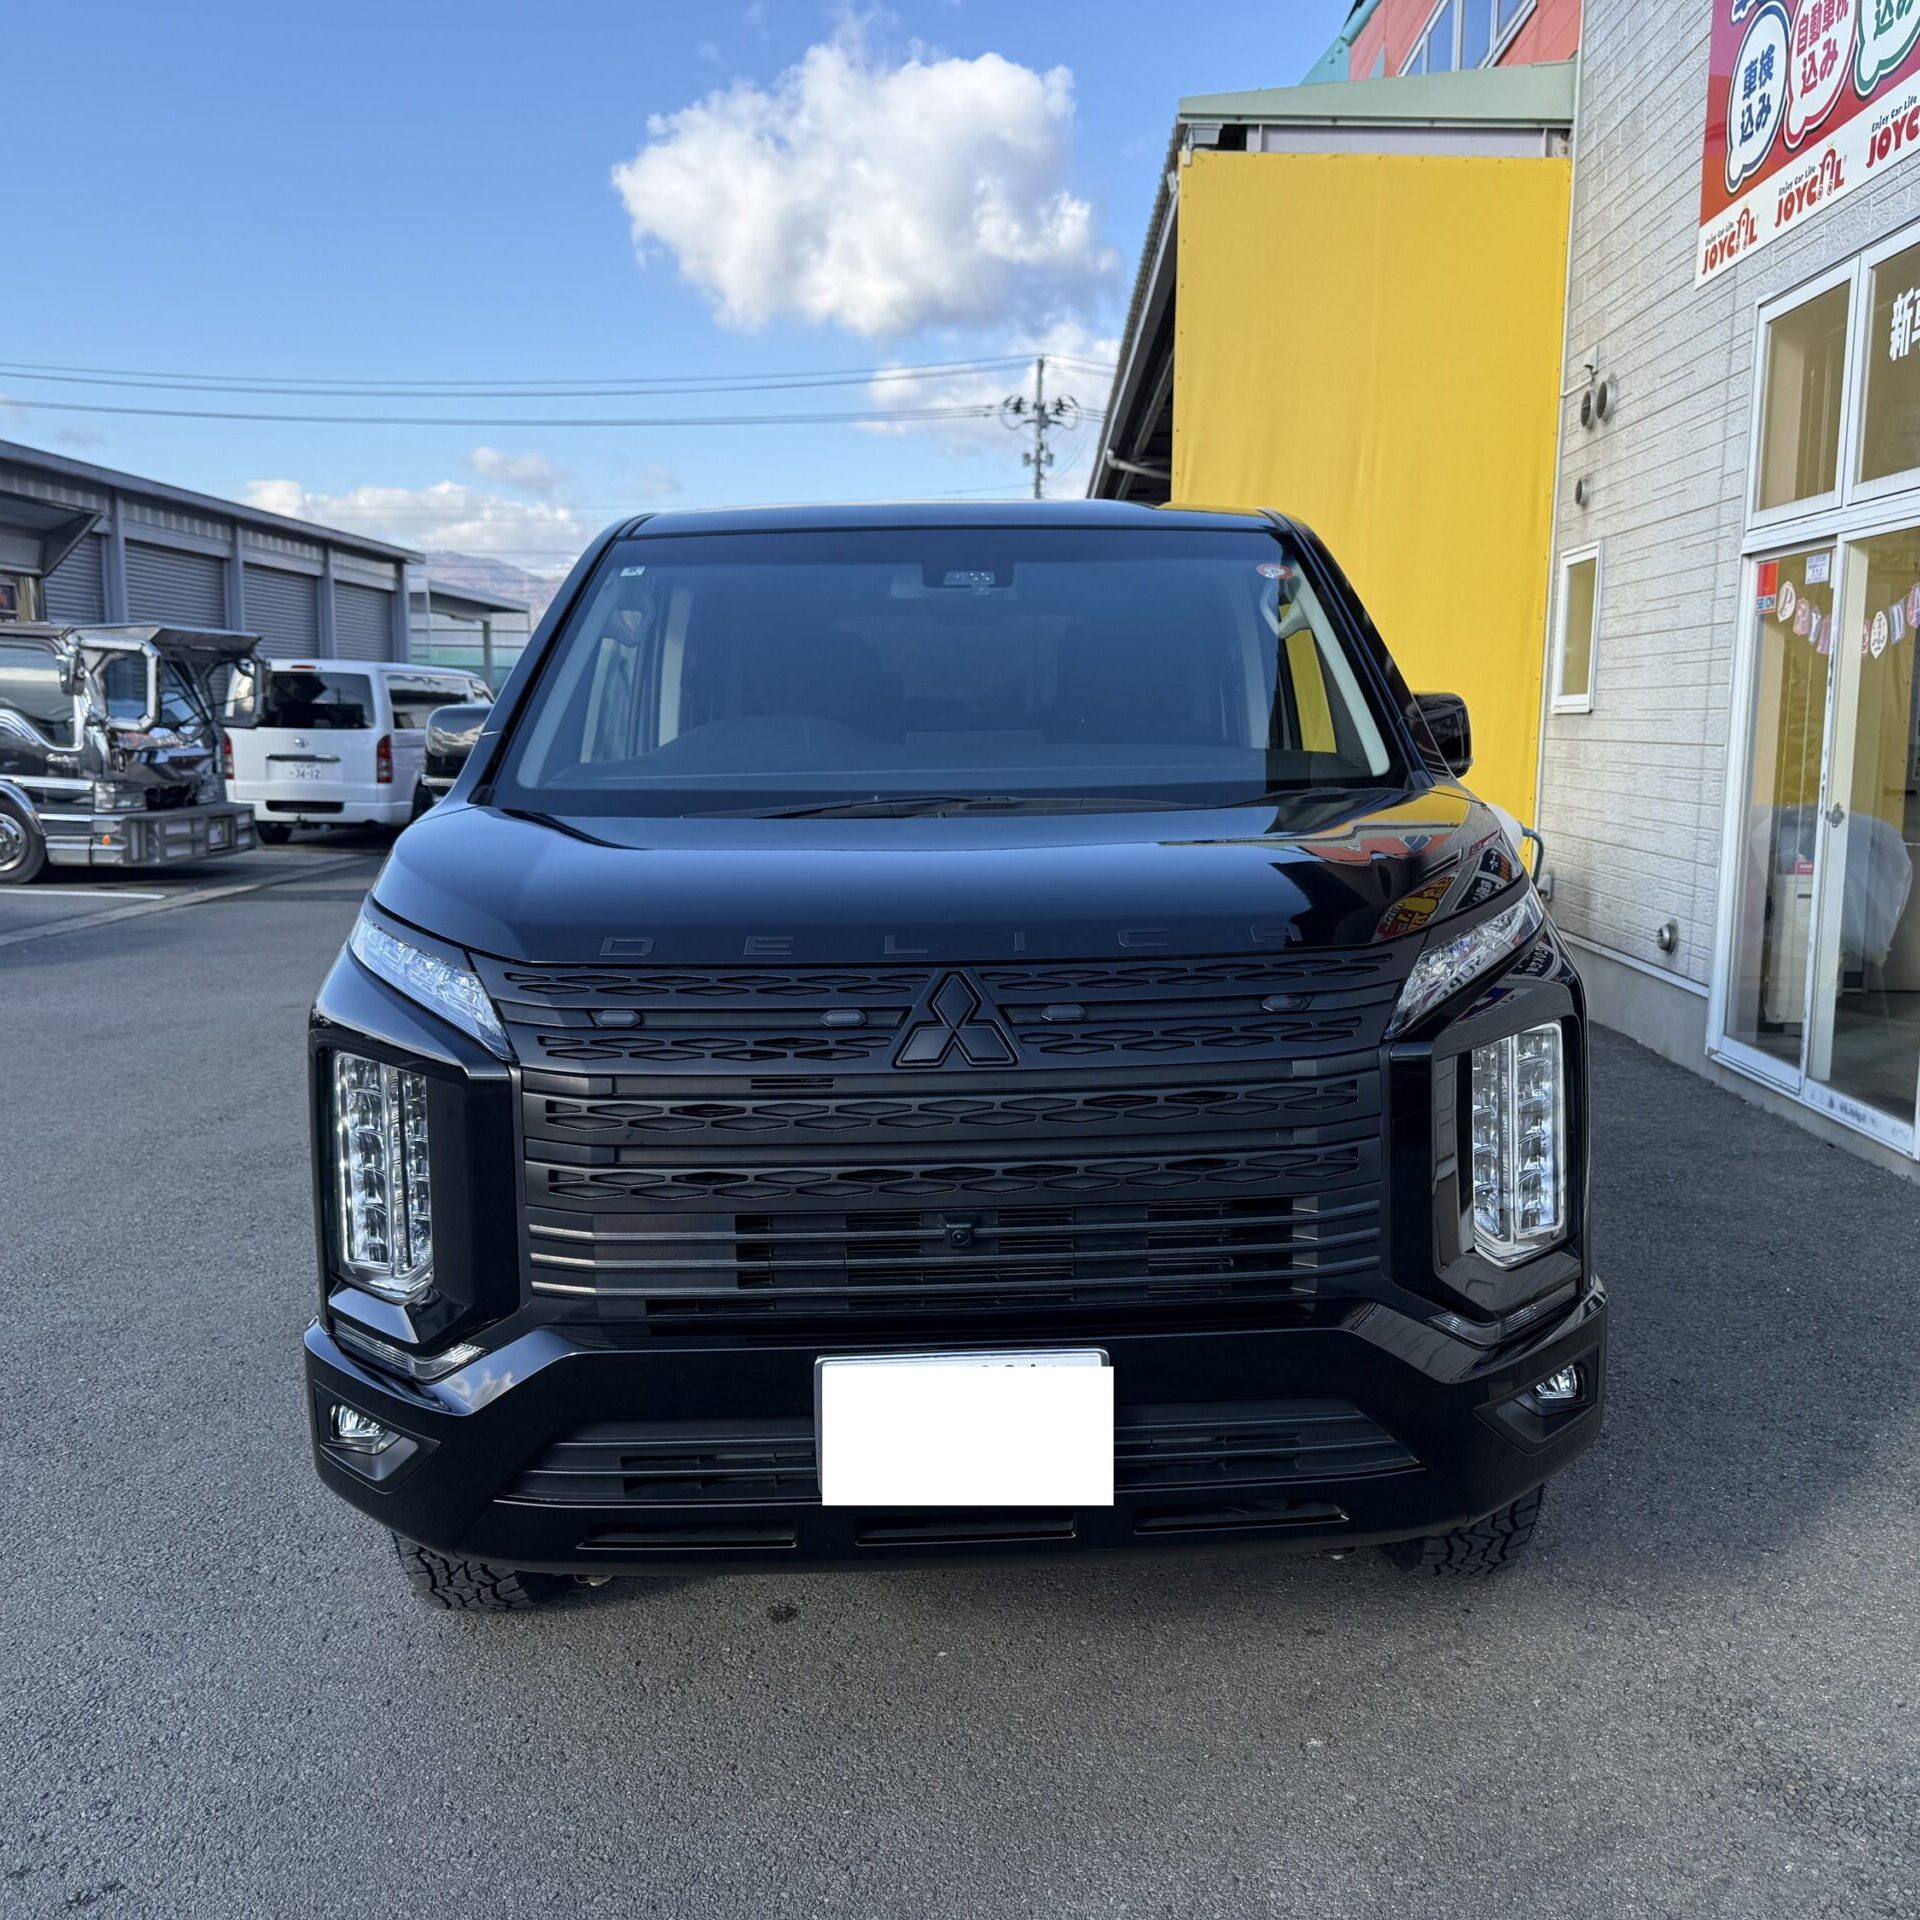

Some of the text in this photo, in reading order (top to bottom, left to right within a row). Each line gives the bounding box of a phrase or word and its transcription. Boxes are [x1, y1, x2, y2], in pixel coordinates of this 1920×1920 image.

[1742, 43, 1776, 101] 車検
[1800, 38, 1839, 99] 込み
[1739, 92, 1772, 147] 込み
[599, 922, 1303, 957] DELICA
